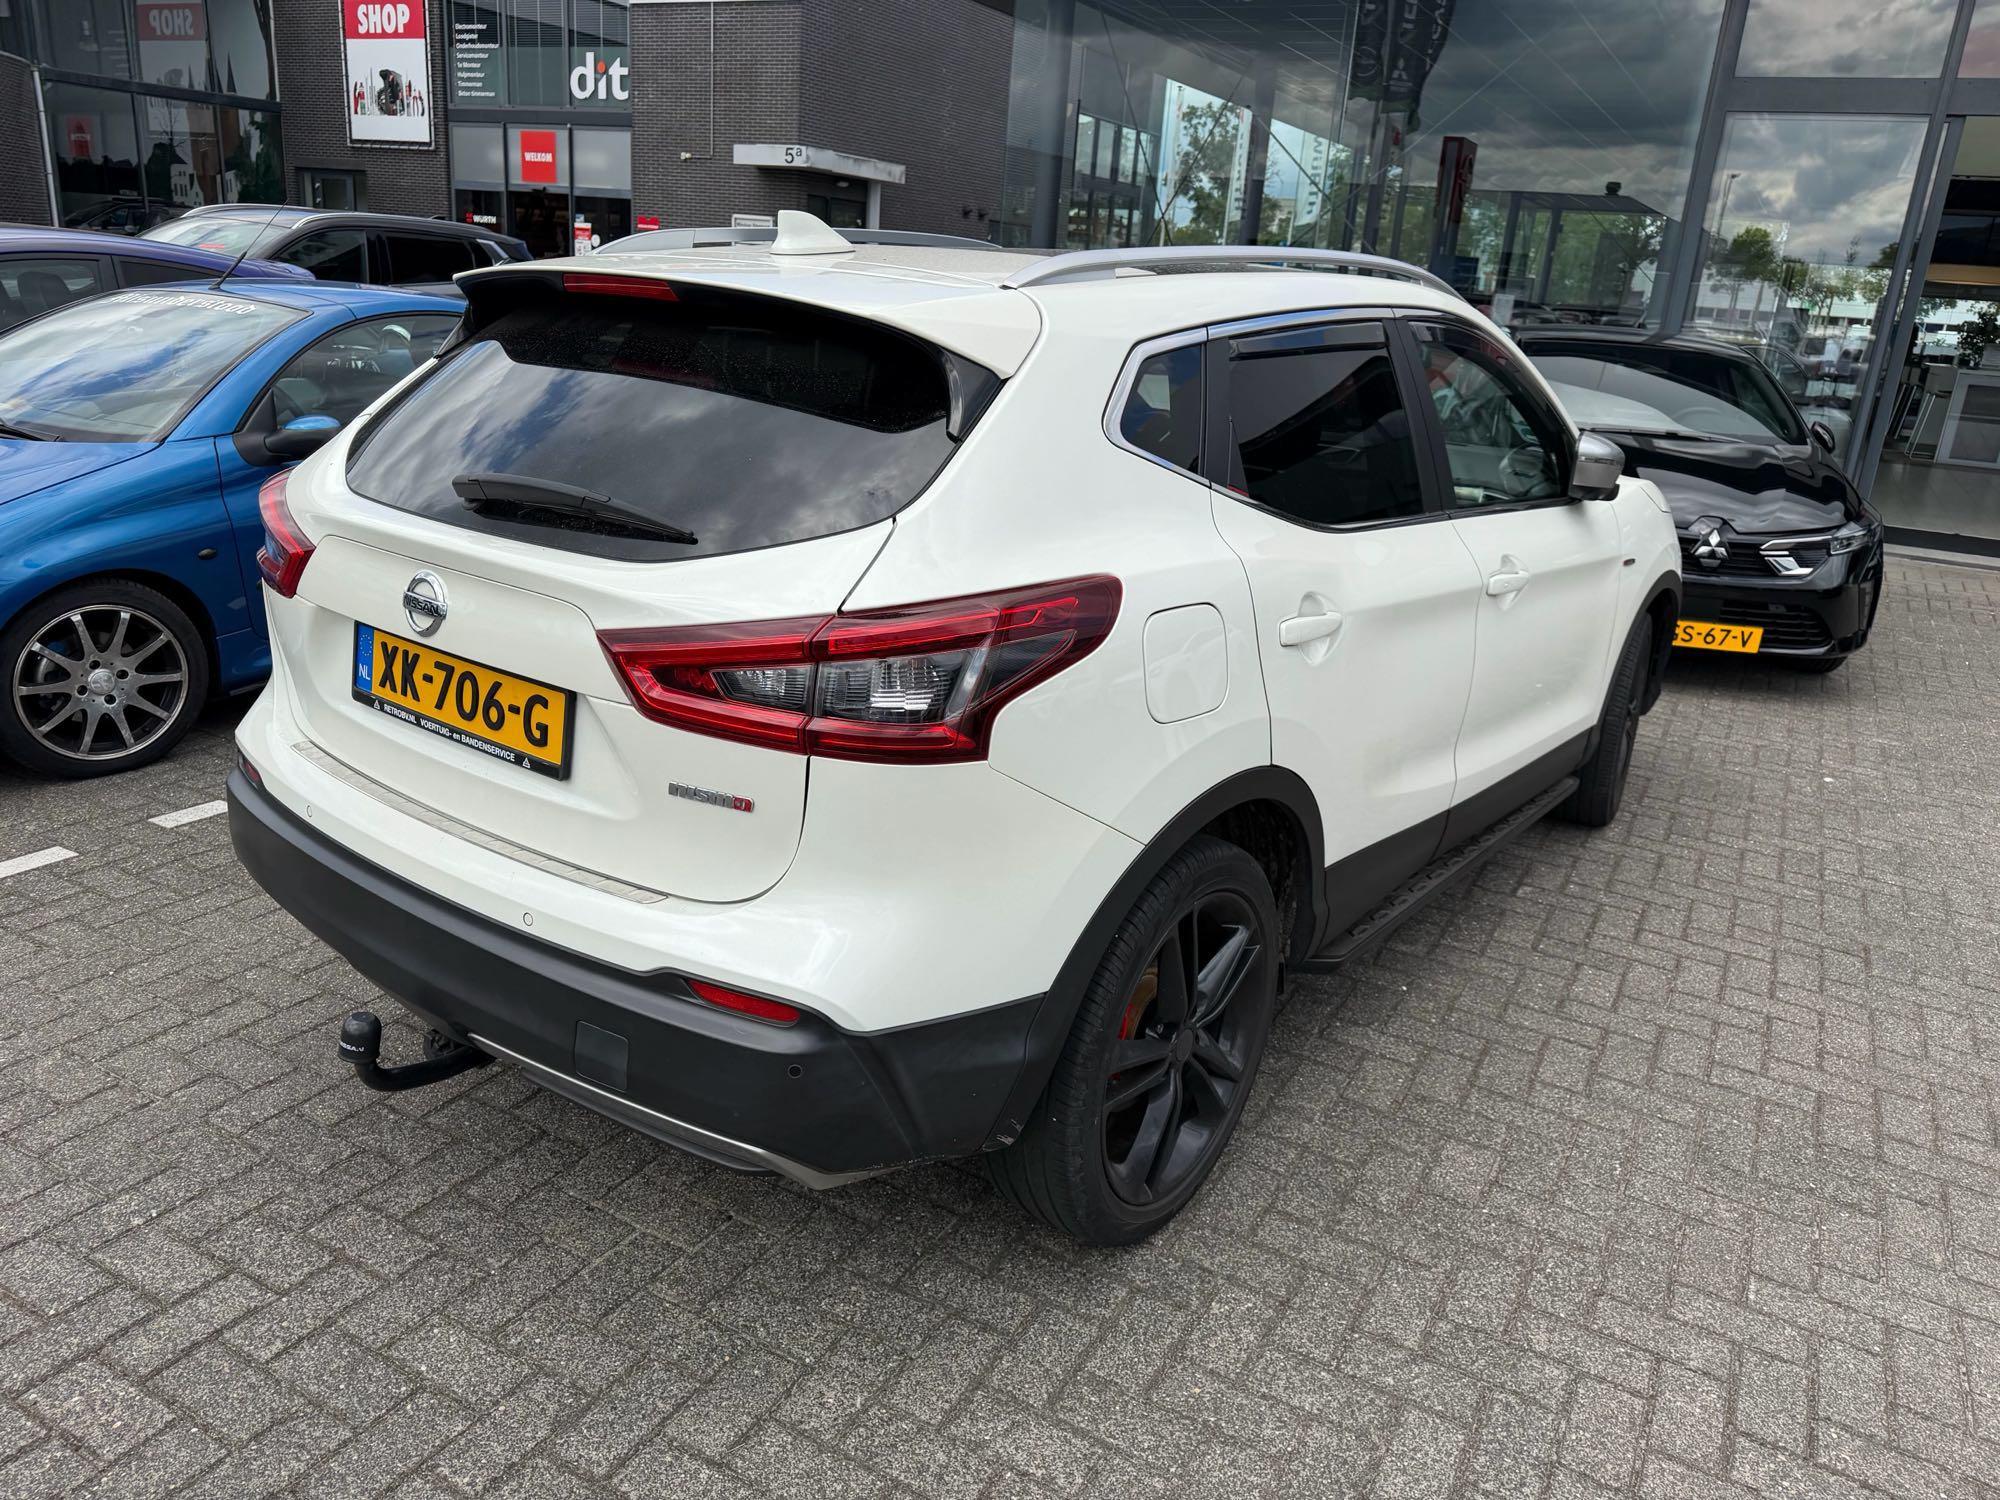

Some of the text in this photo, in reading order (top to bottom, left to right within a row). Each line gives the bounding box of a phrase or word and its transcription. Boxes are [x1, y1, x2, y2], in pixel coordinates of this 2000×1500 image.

[357, 4, 411, 34] SHOP
[570, 51, 629, 100] dit
[524, 152, 553, 163] WELKOM
[404, 593, 440, 617] NISSAN
[358, 663, 371, 681] NL
[378, 640, 549, 748] XK-706-G
[453, 733, 461, 742] en
[461, 734, 516, 762] BANDENSERVICE
